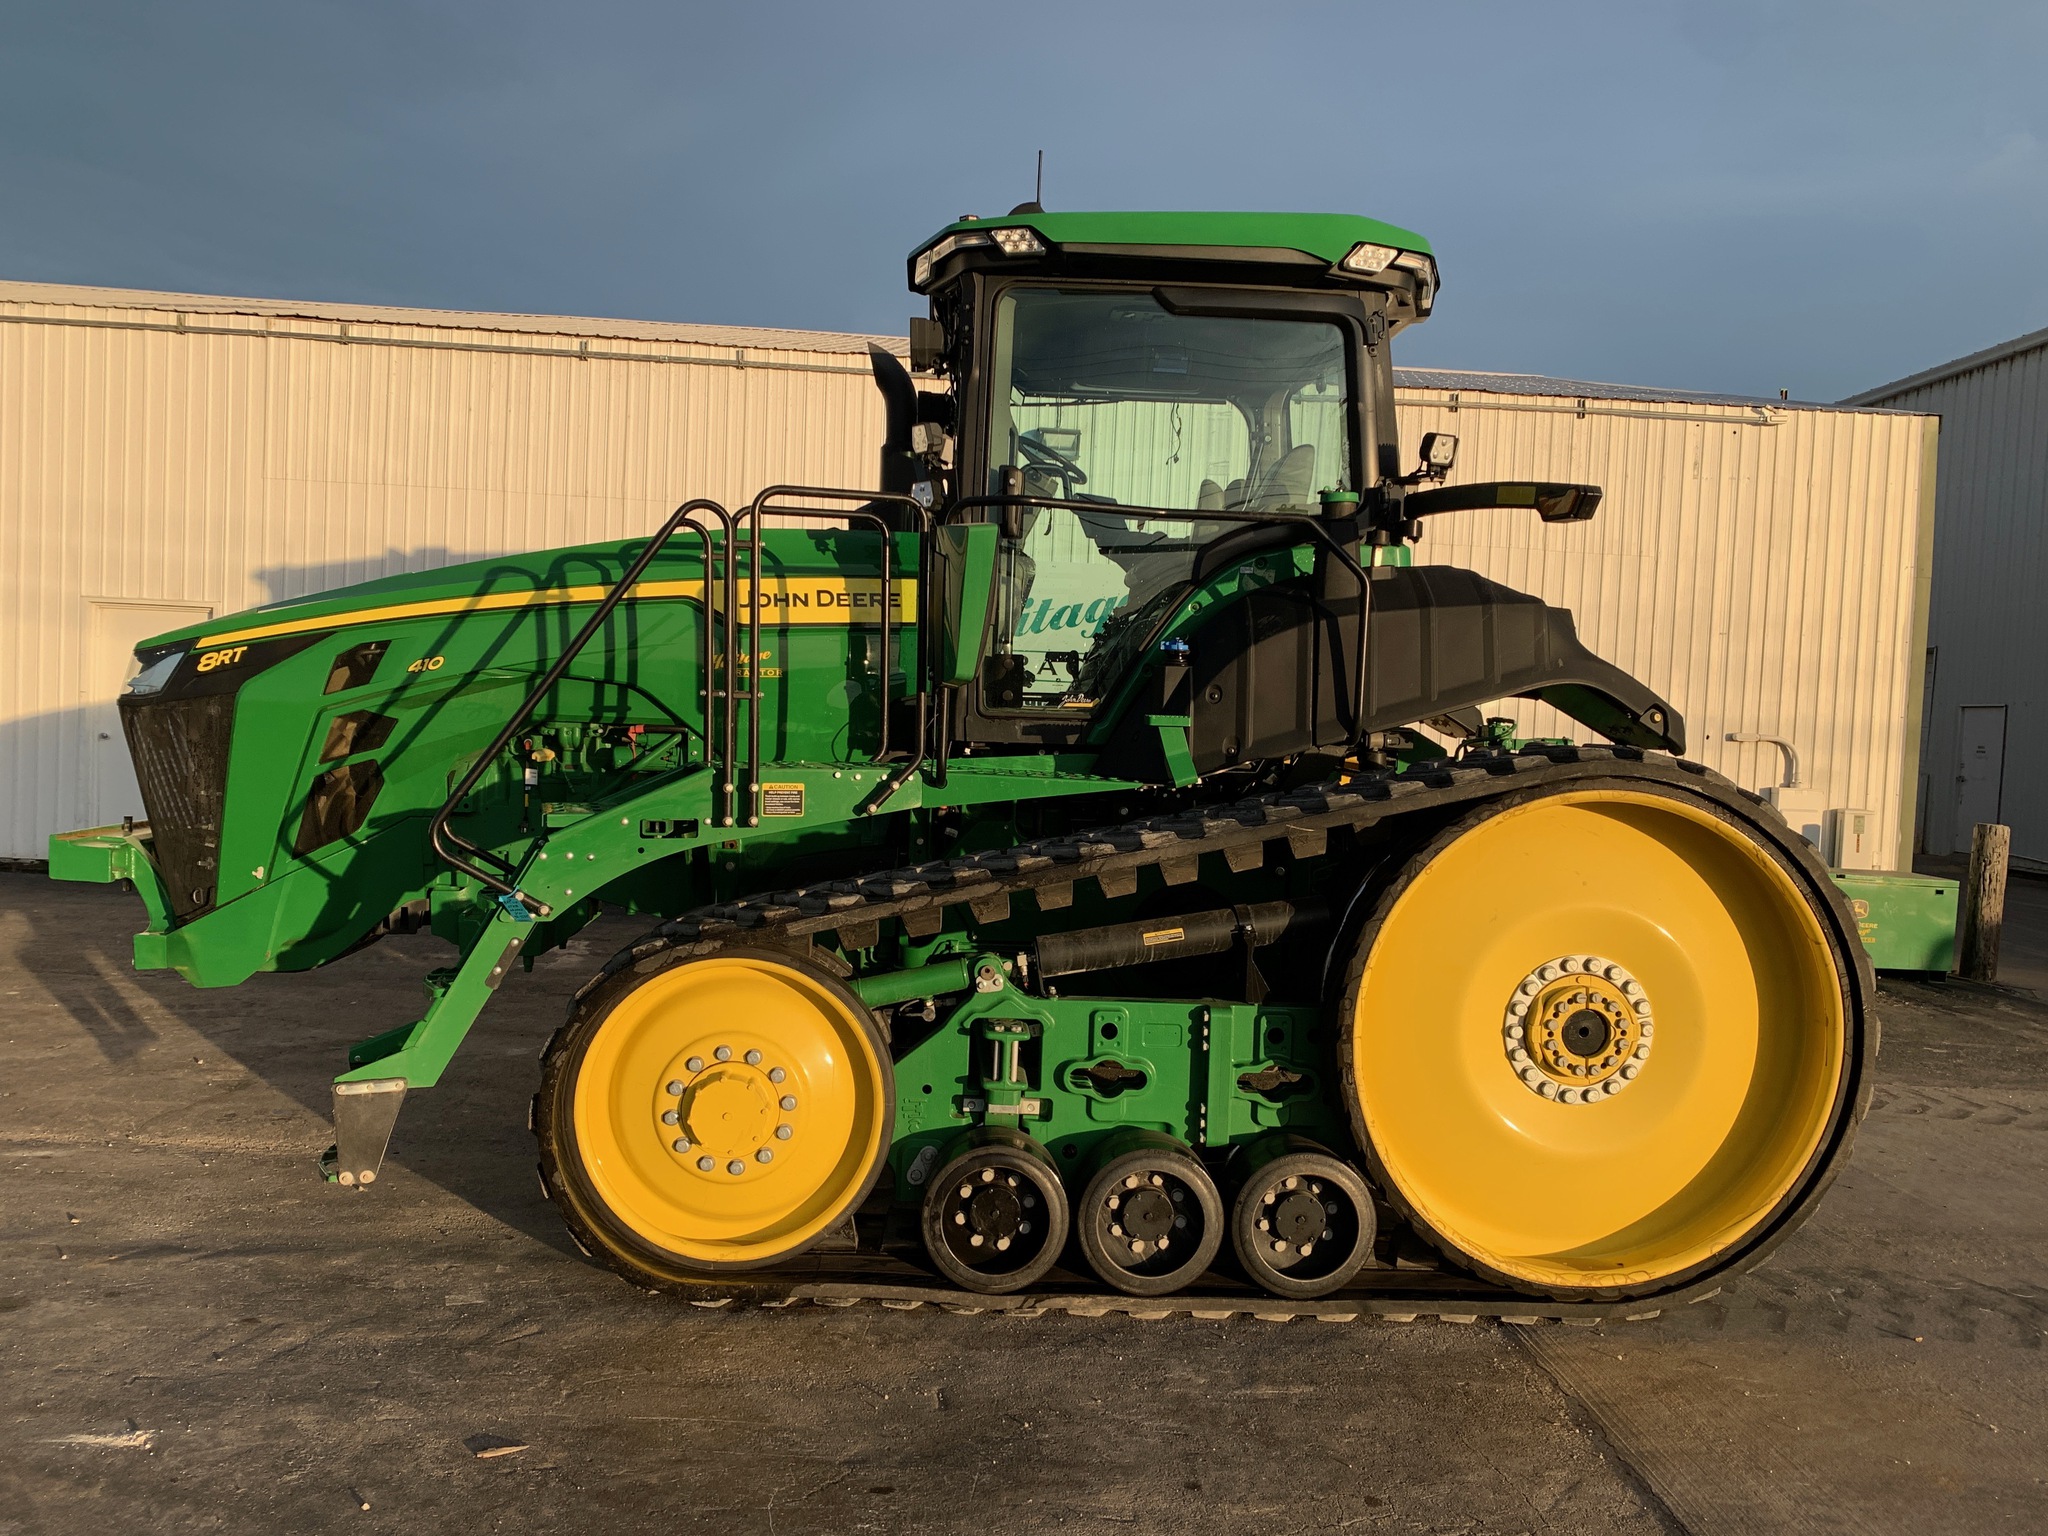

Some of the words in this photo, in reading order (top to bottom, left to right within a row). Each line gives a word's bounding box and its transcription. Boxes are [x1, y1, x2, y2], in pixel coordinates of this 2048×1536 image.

[740, 590, 809, 608] JOHN
[816, 589, 901, 608] DEERE
[1014, 594, 1130, 639] itag
[196, 645, 249, 672] 8RT
[406, 655, 446, 674] 410
